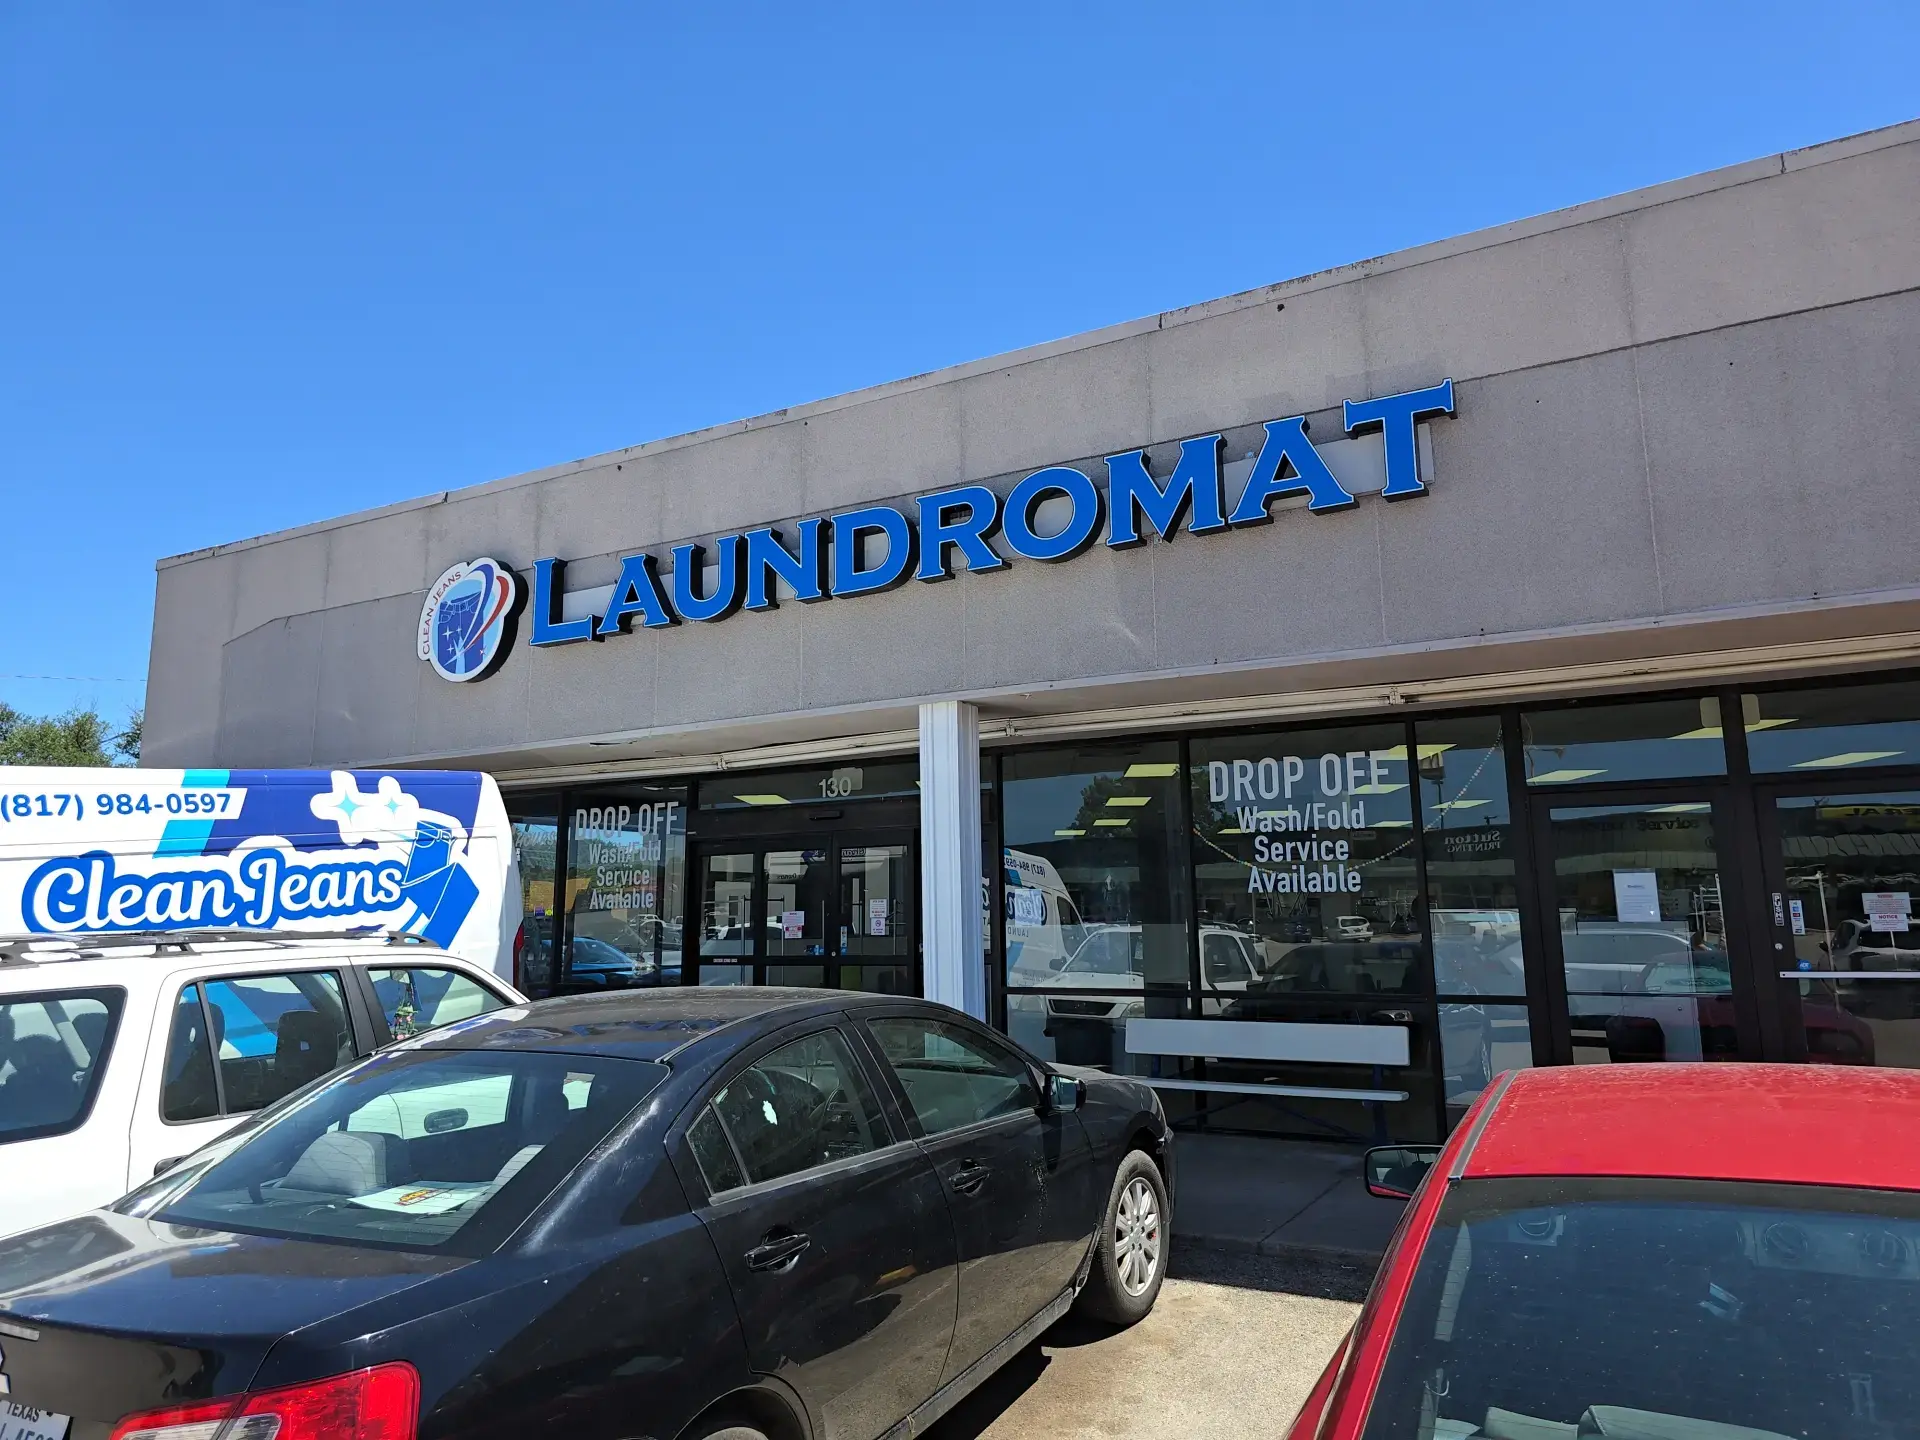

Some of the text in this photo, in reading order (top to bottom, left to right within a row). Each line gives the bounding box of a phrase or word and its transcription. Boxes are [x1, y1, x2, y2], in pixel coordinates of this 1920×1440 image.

[530, 377, 1455, 648] LAUNDROMAT
[422, 571, 462, 655] CLEAN JEANS
[819, 776, 852, 798] 130
[1209, 750, 1389, 803] DROP OFF
[0, 793, 231, 822] (817) 984-0597
[575, 801, 679, 841] DROP OFF
[1237, 801, 1366, 833] Wash/Fold
[589, 840, 662, 864] Wash/Fold
[1254, 834, 1349, 863] Service
[597, 866, 651, 887] Service
[1248, 864, 1362, 893] Available
[33, 856, 402, 932] Clean Jeans
[589, 887, 655, 910] Available
[6, 1402, 41, 1422] TEXAS
